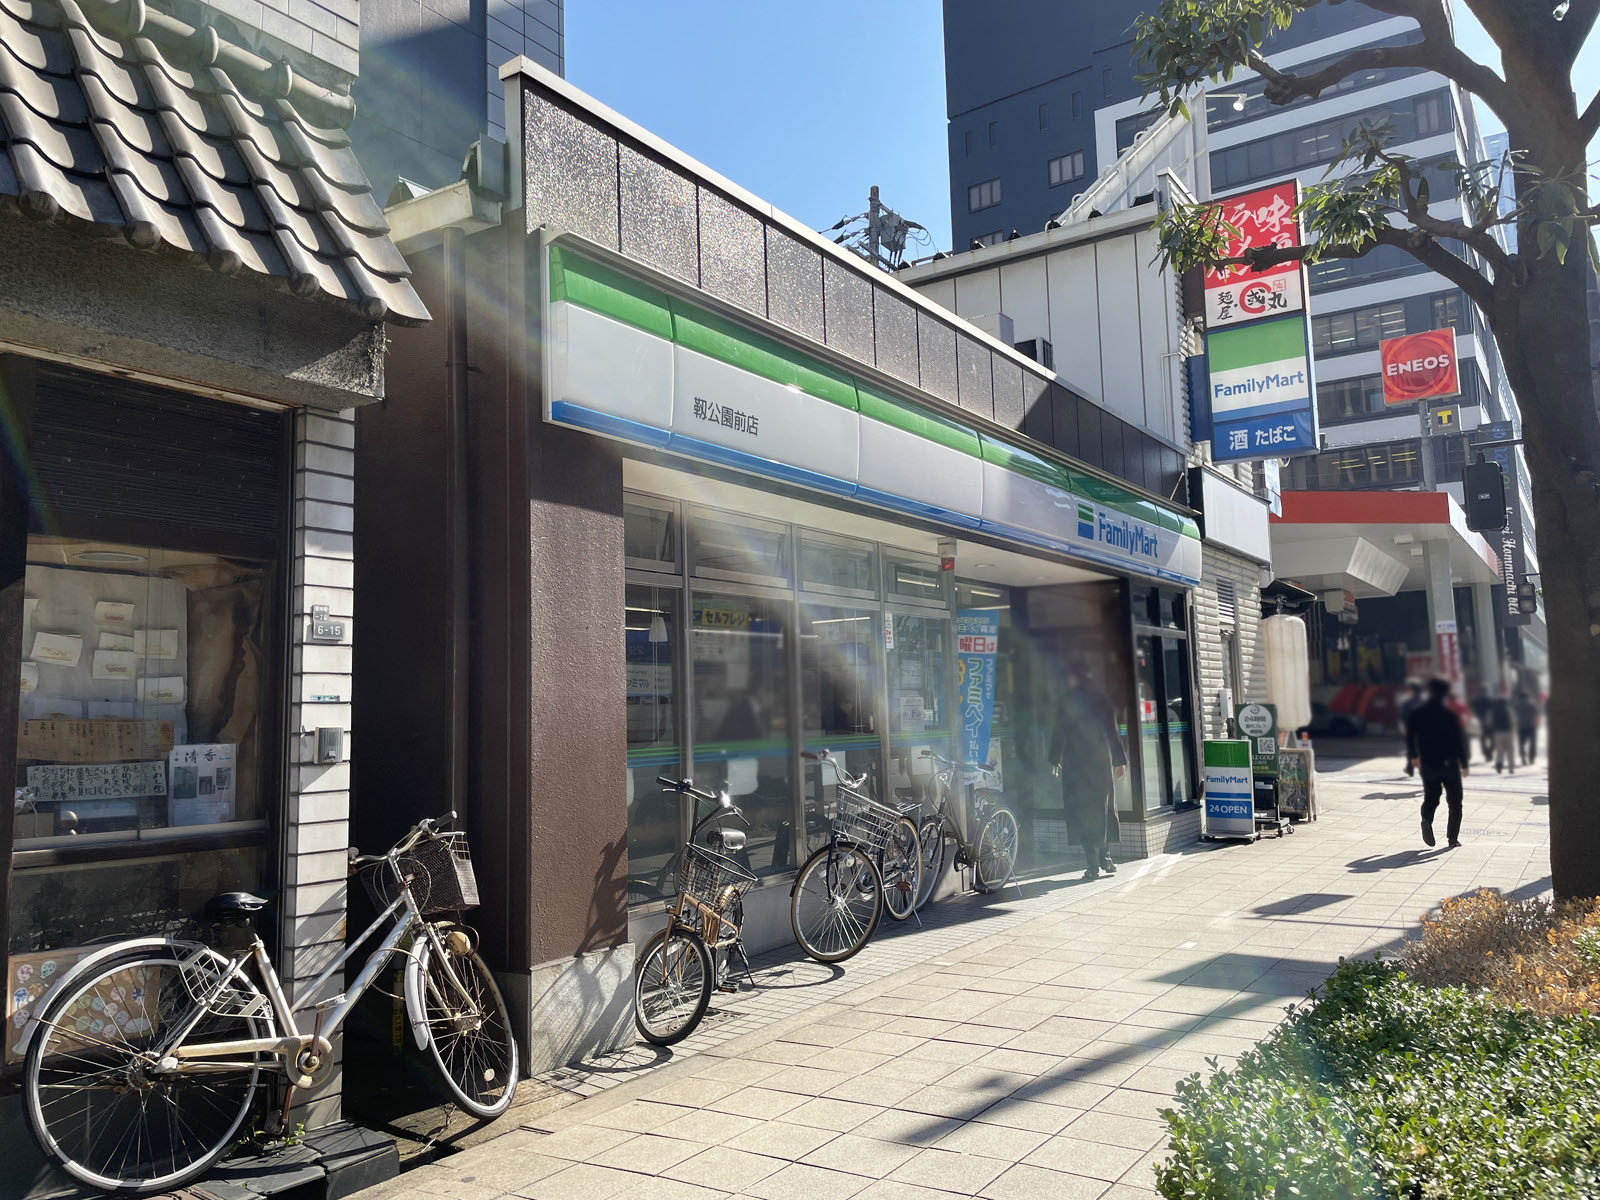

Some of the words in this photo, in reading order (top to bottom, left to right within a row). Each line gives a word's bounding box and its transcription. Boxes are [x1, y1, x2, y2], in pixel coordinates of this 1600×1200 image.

[1386, 354, 1450, 377] ENEOS
[1214, 370, 1304, 399] FamilyMart
[1229, 429, 1249, 451] 酒
[1255, 425, 1296, 446] たばこ
[1098, 511, 1158, 558] FamilyMart
[705, 610, 745, 625] セルフレジ
[317, 625, 341, 636] 6-15
[1206, 775, 1249, 784] FamilyMart
